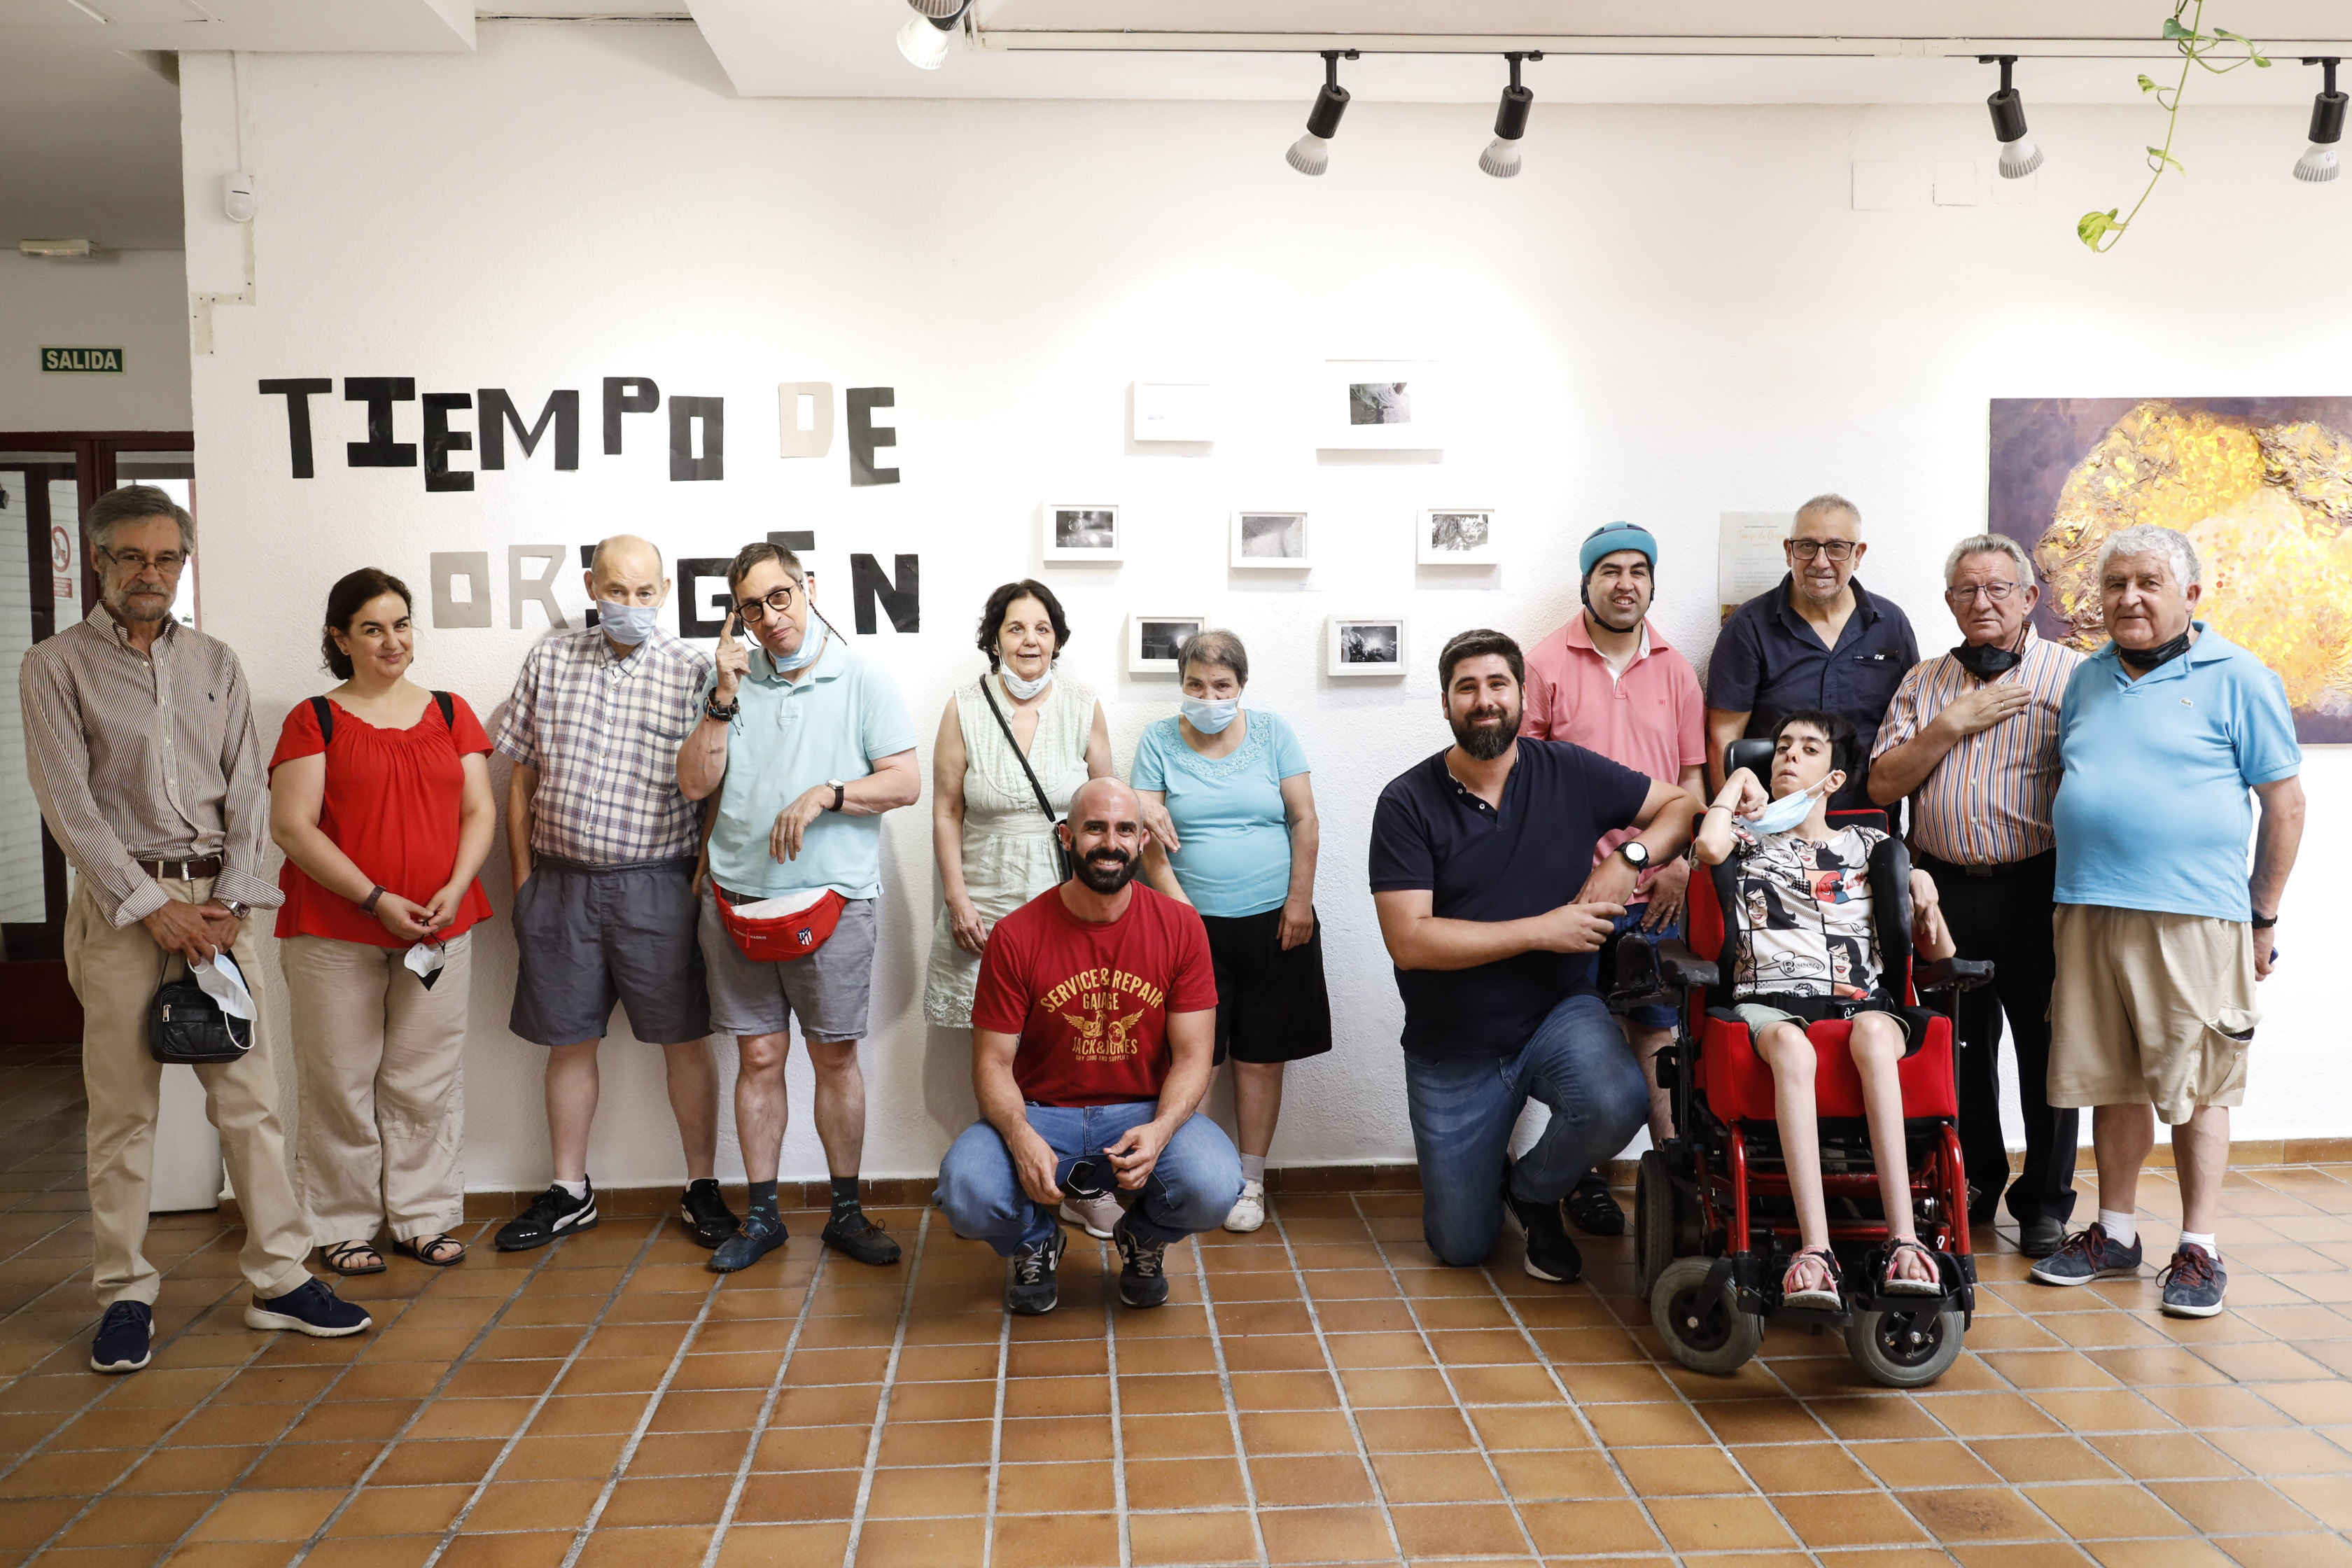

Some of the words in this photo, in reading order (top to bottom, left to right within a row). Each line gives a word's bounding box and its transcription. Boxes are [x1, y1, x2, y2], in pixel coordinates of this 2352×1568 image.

[46, 351, 118, 370] SALIDA
[258, 377, 724, 492] TIEMPO
[778, 382, 900, 487] DE
[430, 531, 919, 638] ORGN
[1040, 969, 1100, 1013] SERVICE
[1112, 969, 1163, 1009] REPAIR
